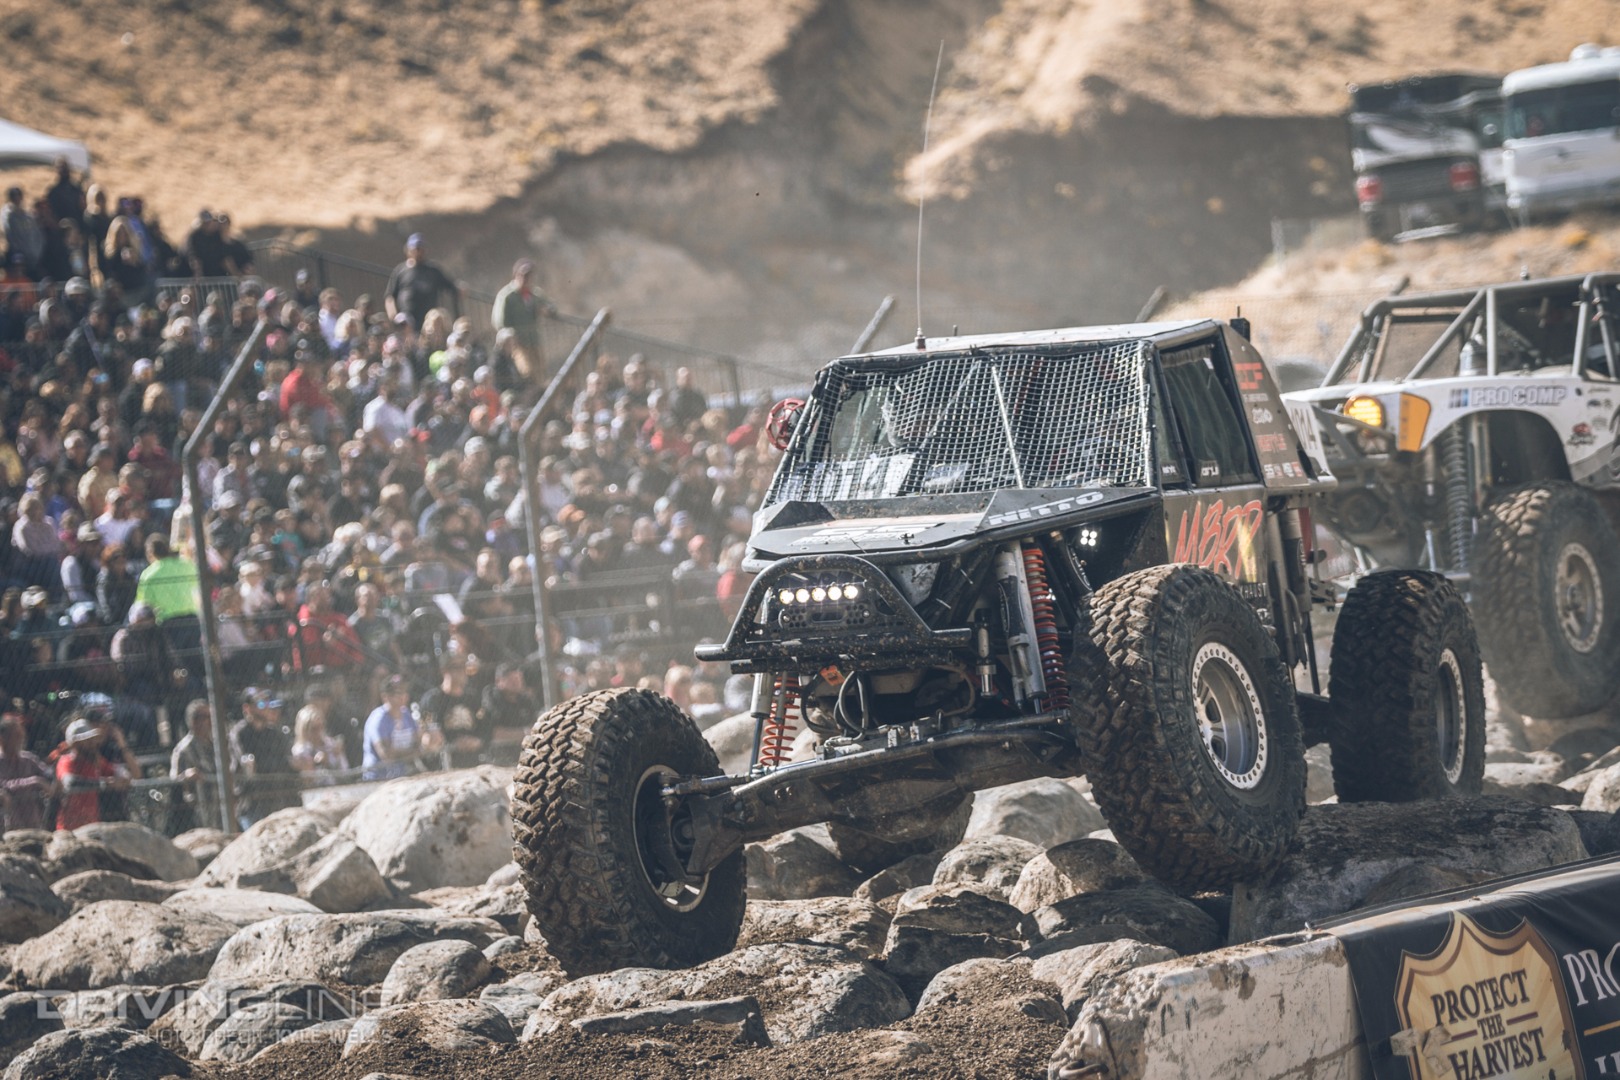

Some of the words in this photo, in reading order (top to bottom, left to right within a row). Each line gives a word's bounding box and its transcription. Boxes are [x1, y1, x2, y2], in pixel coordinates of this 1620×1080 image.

[1471, 386, 1511, 407] PRO
[1512, 385, 1567, 406] COMP
[988, 491, 1104, 526] NITTO
[1174, 499, 1263, 580] MBRP
[1430, 968, 1530, 1027] PROTECT
[1477, 1014, 1506, 1041] THE
[1447, 1026, 1547, 1080] HARVEST
